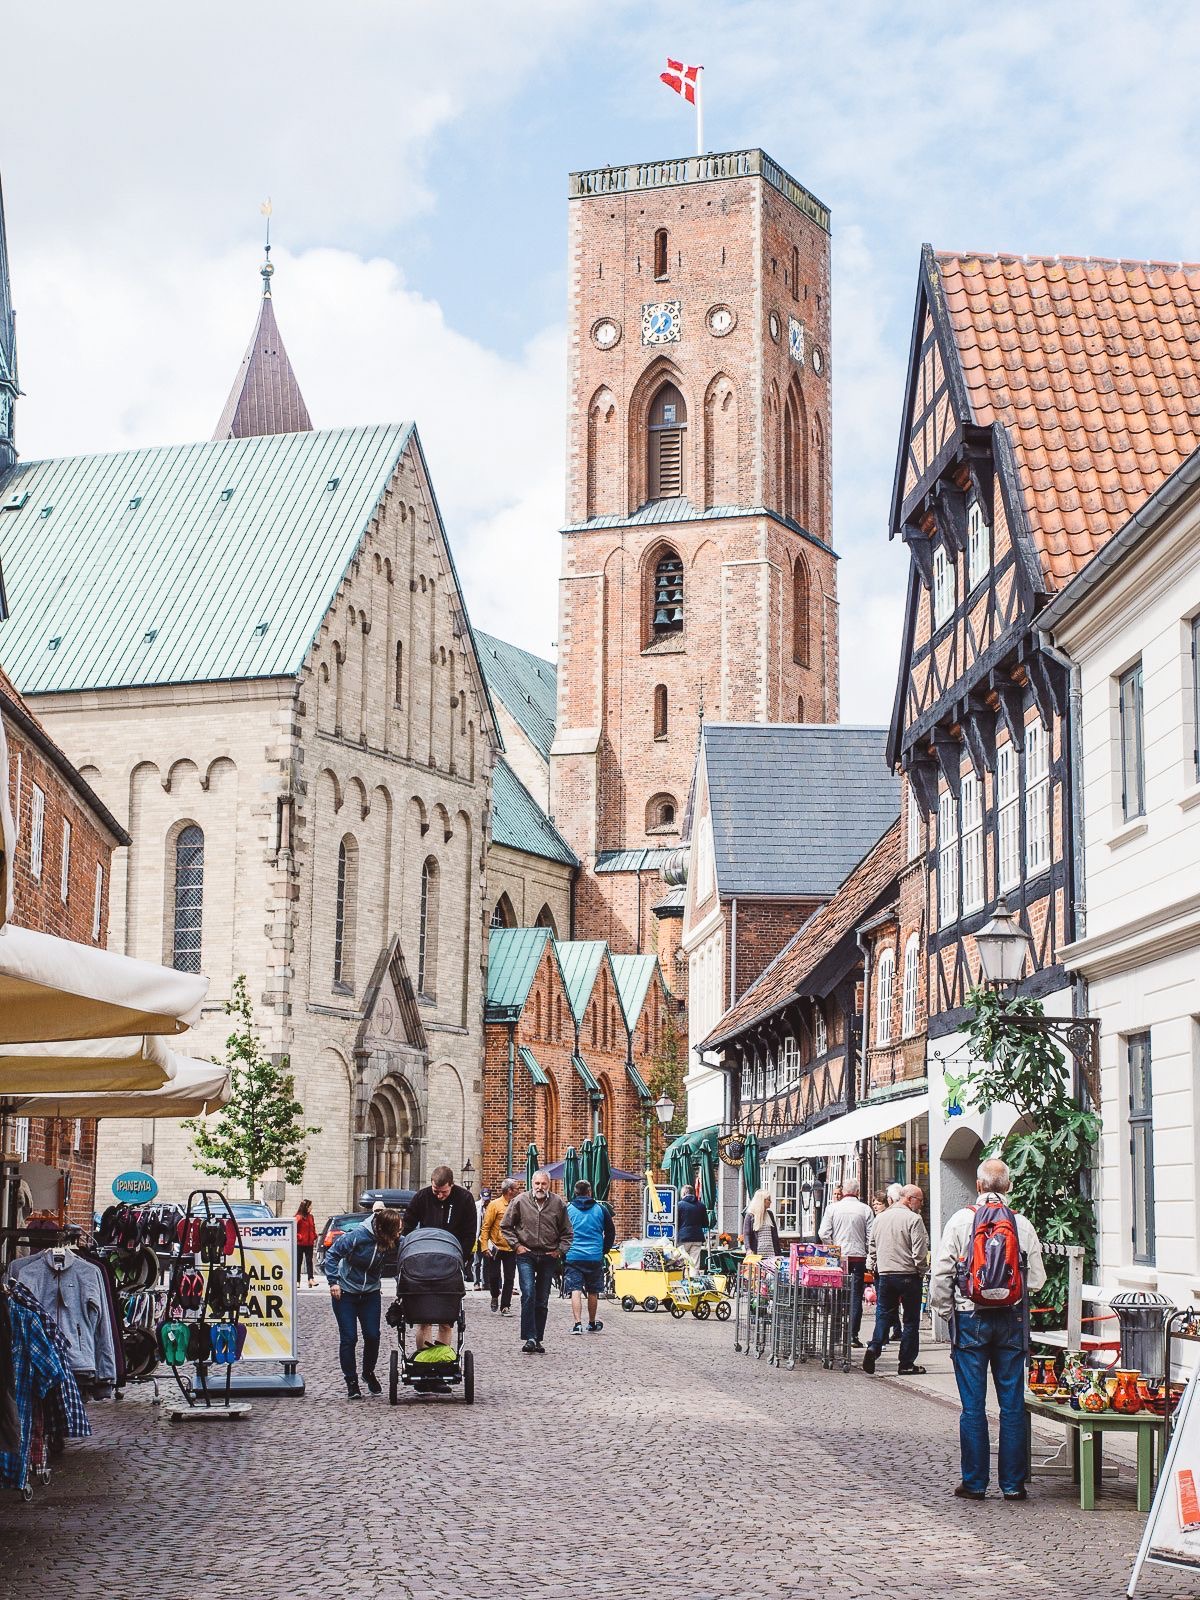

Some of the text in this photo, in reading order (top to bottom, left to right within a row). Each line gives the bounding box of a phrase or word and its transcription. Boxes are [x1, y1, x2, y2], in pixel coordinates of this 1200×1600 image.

[238, 1226, 288, 1237] ERSPORT
[248, 1265, 284, 1280] ALG
[243, 1295, 284, 1319] AR
